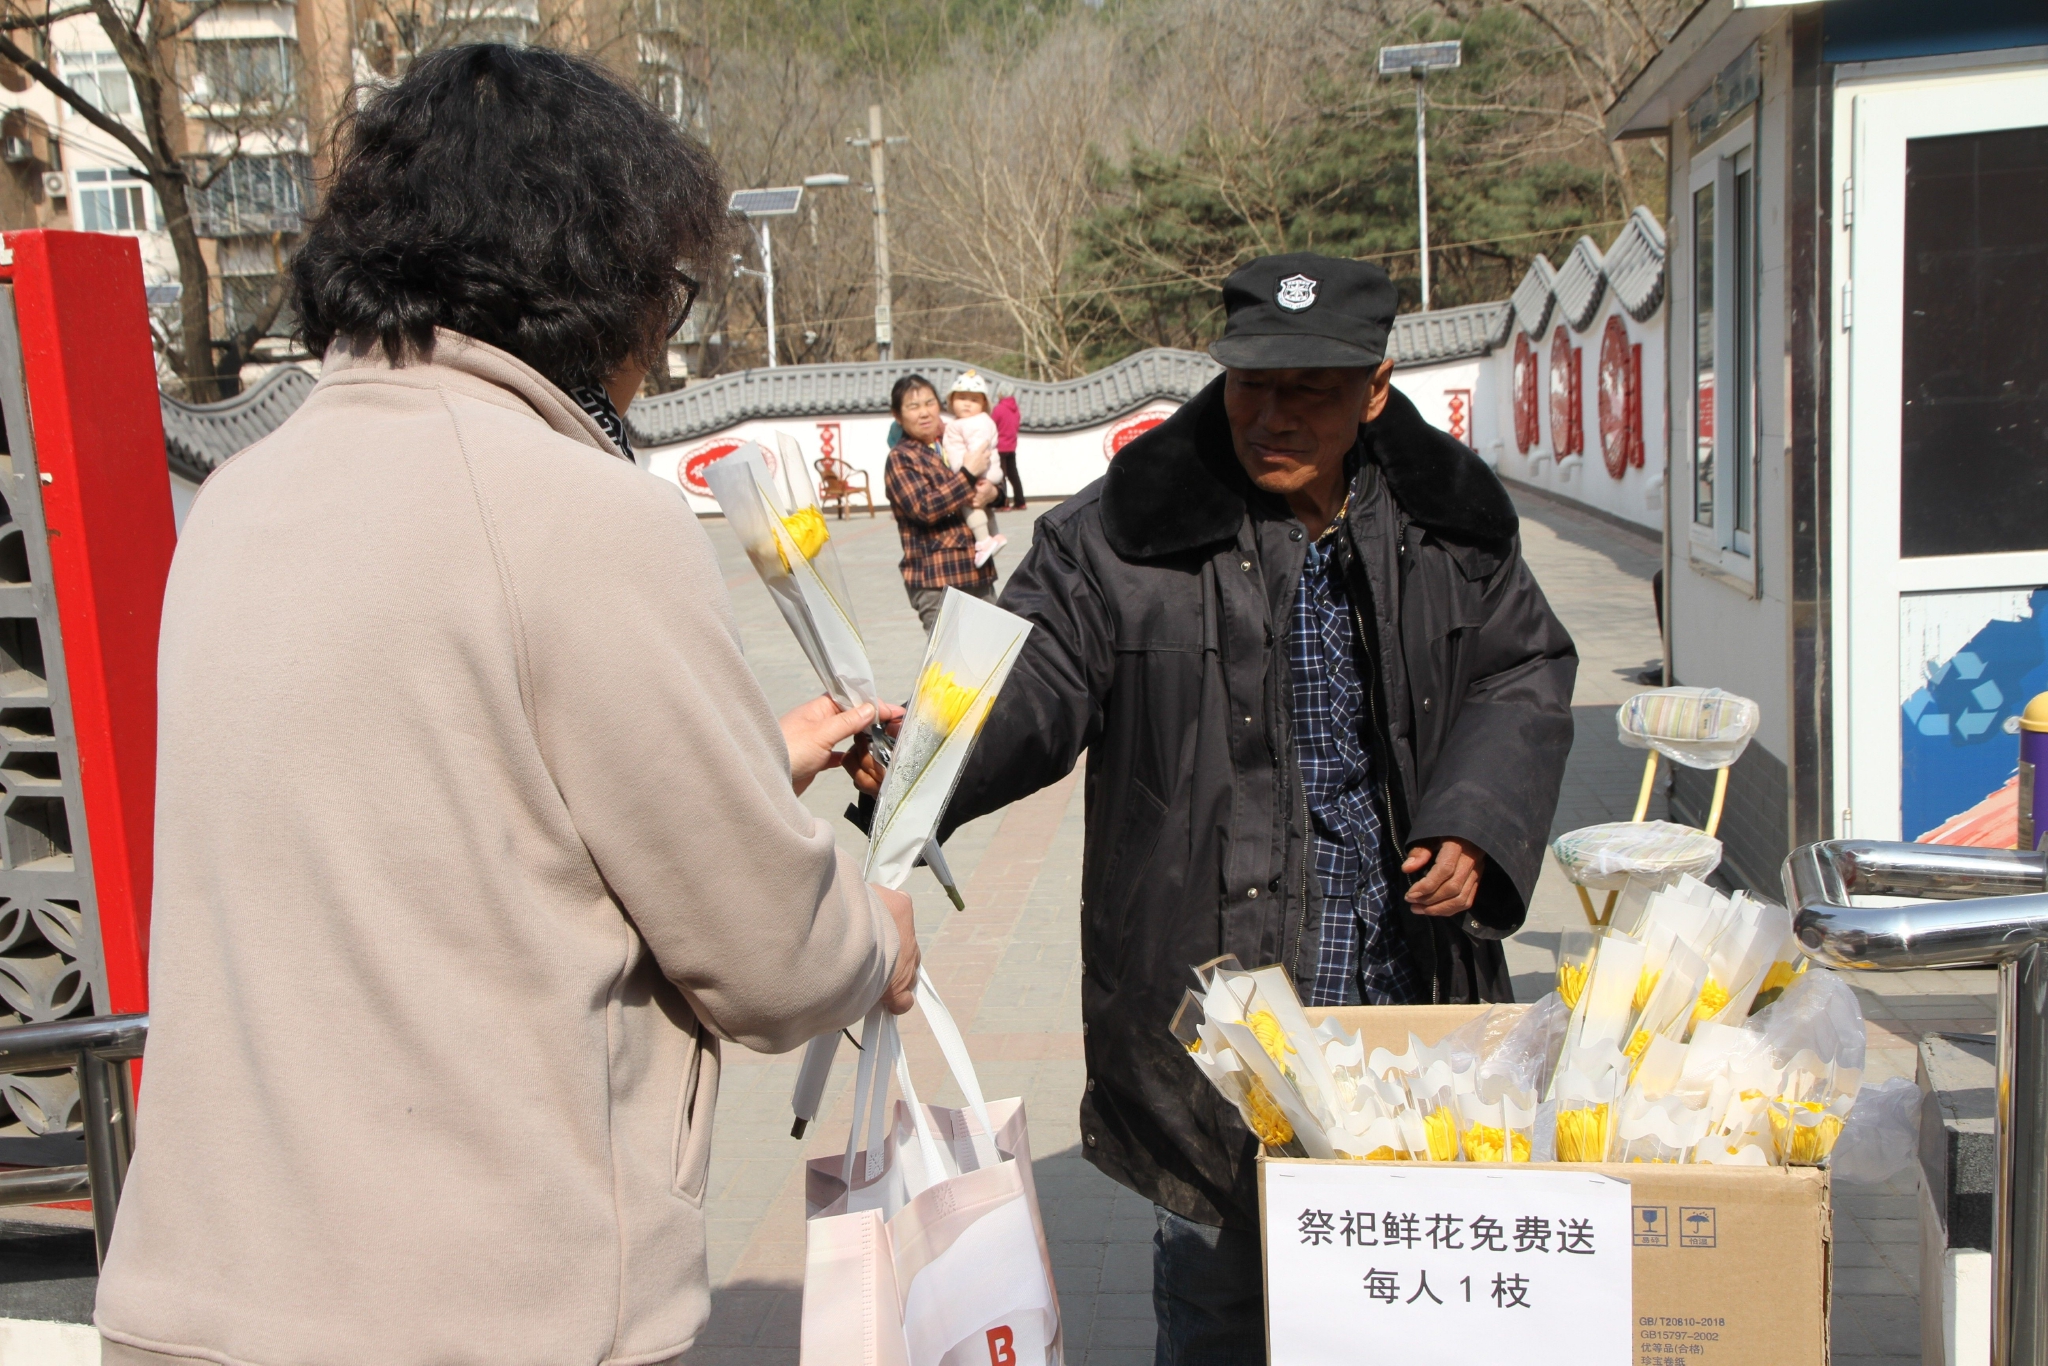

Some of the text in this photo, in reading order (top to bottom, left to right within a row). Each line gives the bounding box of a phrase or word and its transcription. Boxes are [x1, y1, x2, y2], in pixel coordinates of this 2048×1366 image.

[1297, 1208, 1595, 1254] 祭祀鲜花免费送
[985, 1324, 1016, 1366] B
[1640, 1330, 1718, 1341] GB15797-2002
[1641, 1343, 1704, 1355] 优等品(合格)
